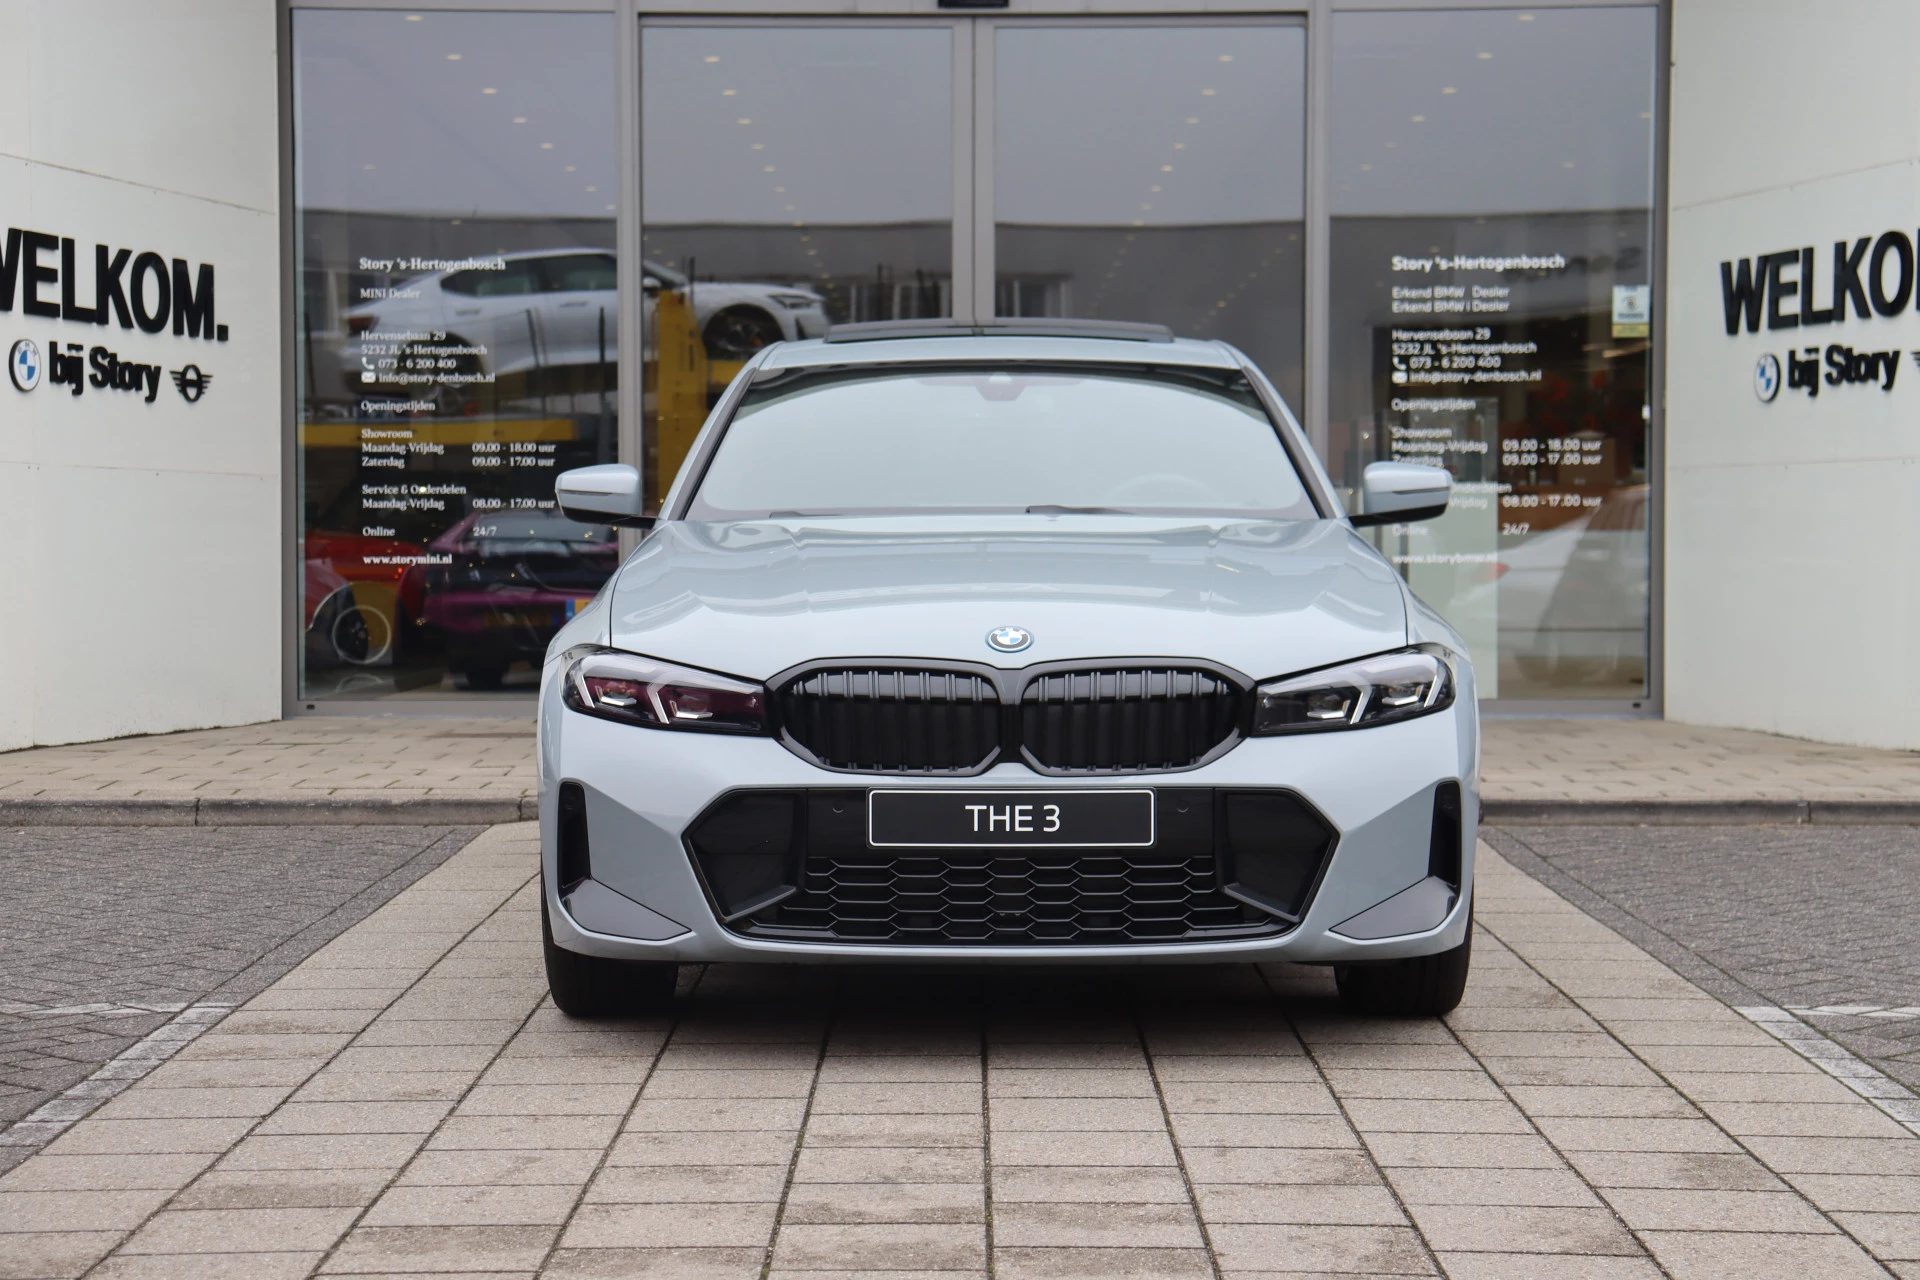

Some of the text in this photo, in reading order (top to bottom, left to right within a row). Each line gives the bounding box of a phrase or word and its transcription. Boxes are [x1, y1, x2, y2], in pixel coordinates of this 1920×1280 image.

[360, 257, 394, 272] Story
[1391, 255, 1433, 273] Story
[1720, 230, 1920, 335] WELKO
[360, 287, 421, 299] MINI Dealer
[1392, 285, 1511, 299] Erkend BMW Dealer
[1392, 300, 1432, 313] Erkend
[1433, 300, 1465, 313] BMW
[1472, 300, 1511, 312] Dealer
[433, 330, 446, 341] 29
[1475, 327, 1492, 341] 29
[361, 344, 387, 355] 5232
[1392, 343, 1421, 355] 5232
[378, 358, 398, 369] 073
[406, 358, 414, 369] 6
[416, 358, 435, 369] 200
[437, 358, 457, 369] 400
[1409, 356, 1432, 369] 073
[1441, 356, 1450, 368] 6
[1452, 356, 1475, 368] 200
[1477, 356, 1501, 368] 400
[49, 341, 161, 403] bij Story
[1409, 370, 1542, 384] info@story-denbosch.nl
[1788, 344, 1901, 398] bij Story
[379, 372, 496, 385] info@story-denbosch.nl
[361, 400, 436, 413] Openingstijden
[1391, 398, 1476, 412] Openingstijden
[361, 427, 413, 439] Showroom
[1391, 427, 1452, 439] Showroom
[362, 442, 445, 455] Maandag-Vrijdag
[472, 442, 500, 453] 09.00
[509, 442, 537, 453] 18.00
[538, 444, 556, 453] uur
[1392, 440, 1488, 454] Maandag-Vrijdag
[1502, 439, 1538, 452] 09.00
[1547, 438, 1580, 451] 18.00
[1582, 441, 1602, 451] uur
[362, 456, 405, 469] Zaterdag
[472, 456, 500, 467] 09.00
[509, 456, 536, 467] 17.00
[538, 458, 556, 467] uur
[1502, 453, 1538, 466] 09.00
[1582, 455, 1602, 465] uur
[362, 484, 399, 495] Service
[401, 484, 408, 495] &
[363, 498, 445, 511] Maandag-Vrijdag
[472, 498, 500, 509] 08.00
[509, 498, 536, 509] 17.00
[538, 500, 556, 509] uur
[1502, 495, 1538, 507] 08.00
[1582, 497, 1602, 507] uur
[363, 526, 497, 537] Online 24/7
[1503, 523, 1530, 536] 24/7
[363, 554, 453, 566] www.storymini.nl
[965, 804, 1061, 832] THE 3
